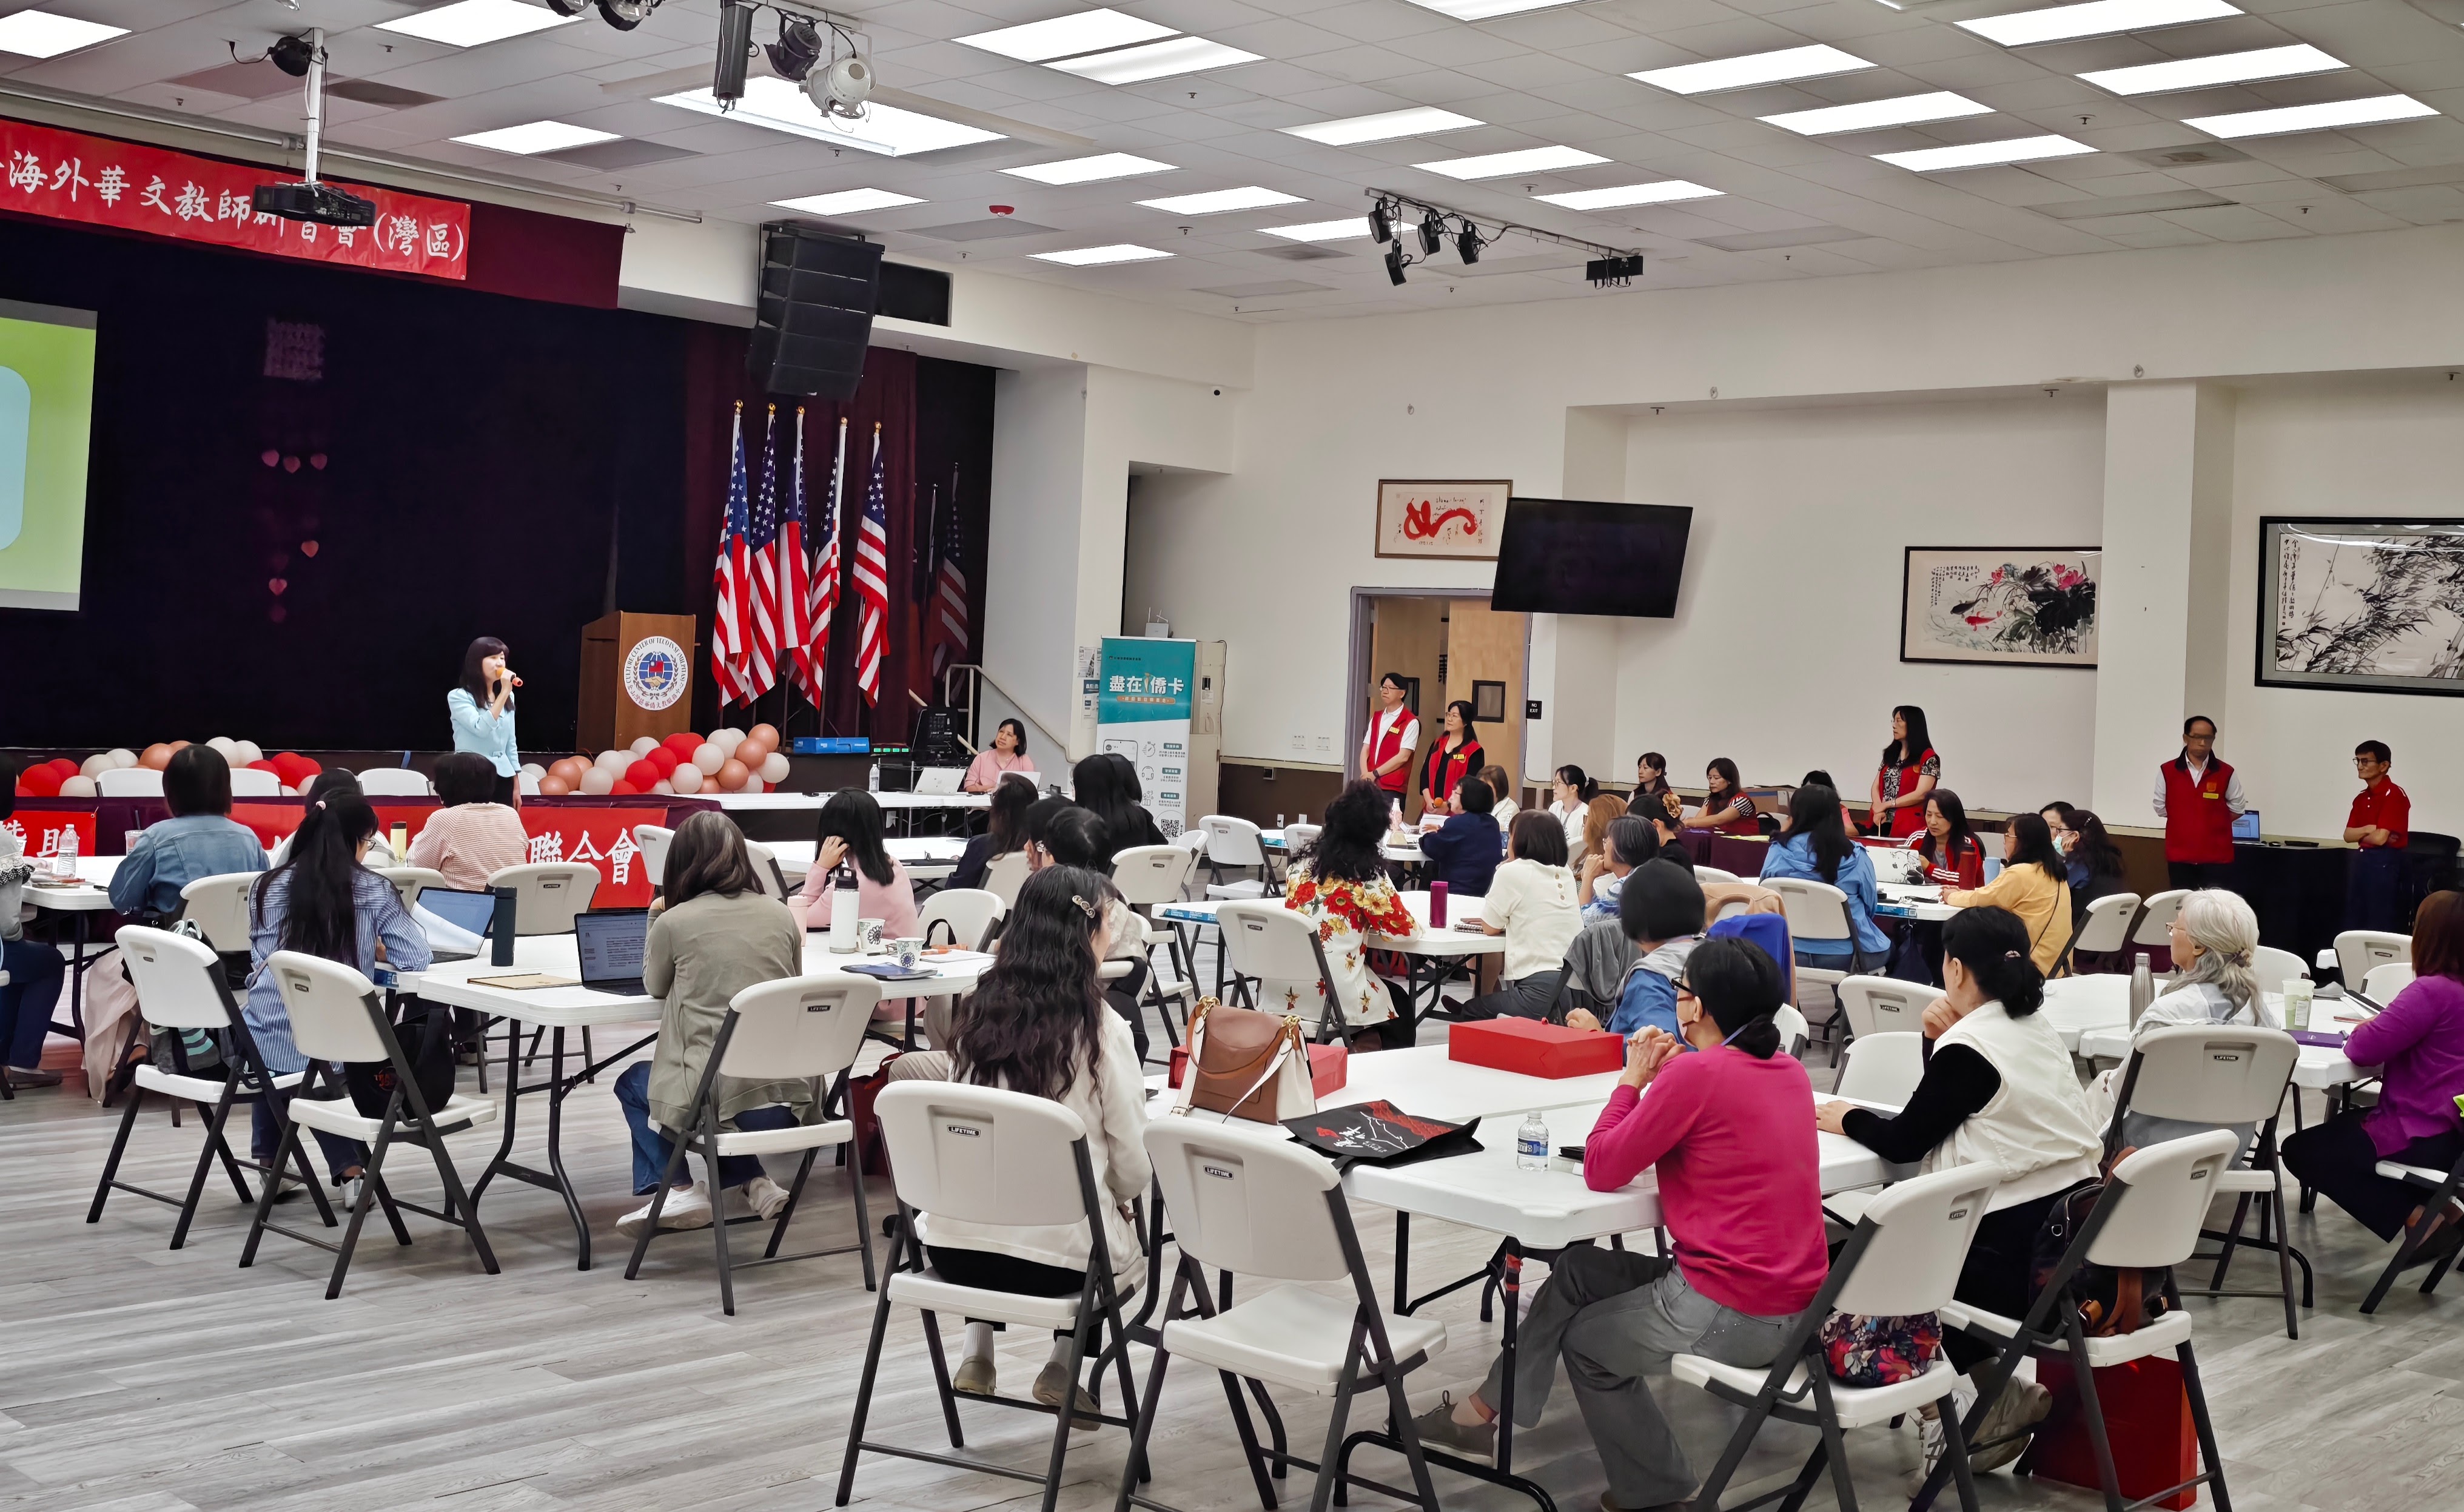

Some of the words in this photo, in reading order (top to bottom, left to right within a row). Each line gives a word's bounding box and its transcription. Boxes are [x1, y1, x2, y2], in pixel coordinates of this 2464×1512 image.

[625, 657, 634, 684] CULTURE
[631, 640, 650, 658] CENTER
[656, 637, 670, 646] TECO
[1207, 1168, 1230, 1177] LIFETIME
